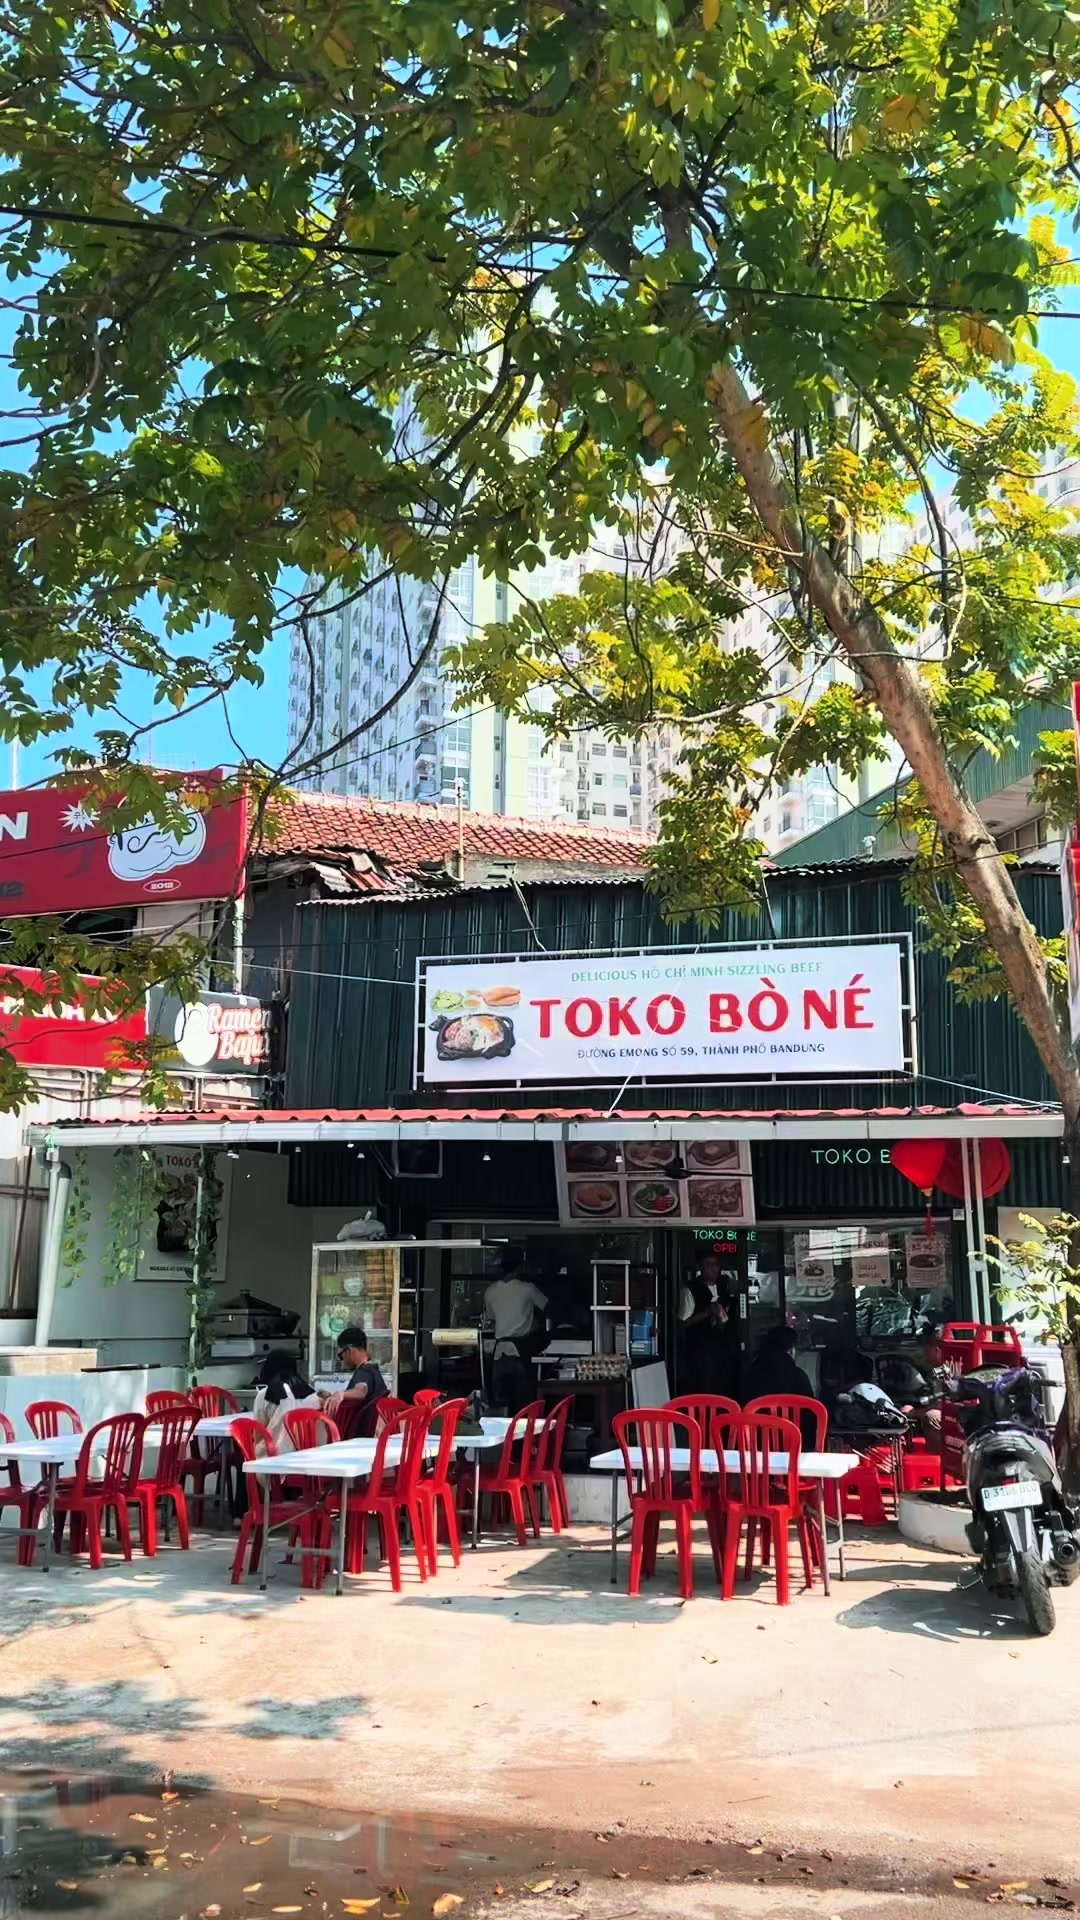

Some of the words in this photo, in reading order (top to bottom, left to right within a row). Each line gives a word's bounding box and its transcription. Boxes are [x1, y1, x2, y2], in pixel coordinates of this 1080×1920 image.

[571, 969, 637, 982] DELICIOUS
[690, 966, 723, 977] MINH
[728, 963, 786, 976] SIZZLING
[791, 961, 823, 973] BEEF
[529, 994, 686, 1038] TOKO
[709, 977, 789, 1032] BÒ
[803, 973, 874, 1030] NÉ
[208, 1003, 272, 1034] Ramen
[620, 1047, 658, 1057] EMONG
[702, 1043, 739, 1056] THÀNH
[770, 1043, 825, 1054] BANDUNG
[810, 1148, 872, 1164] TOKO
[692, 1229, 724, 1240] TOKO
[713, 1242, 737, 1253] OPE
